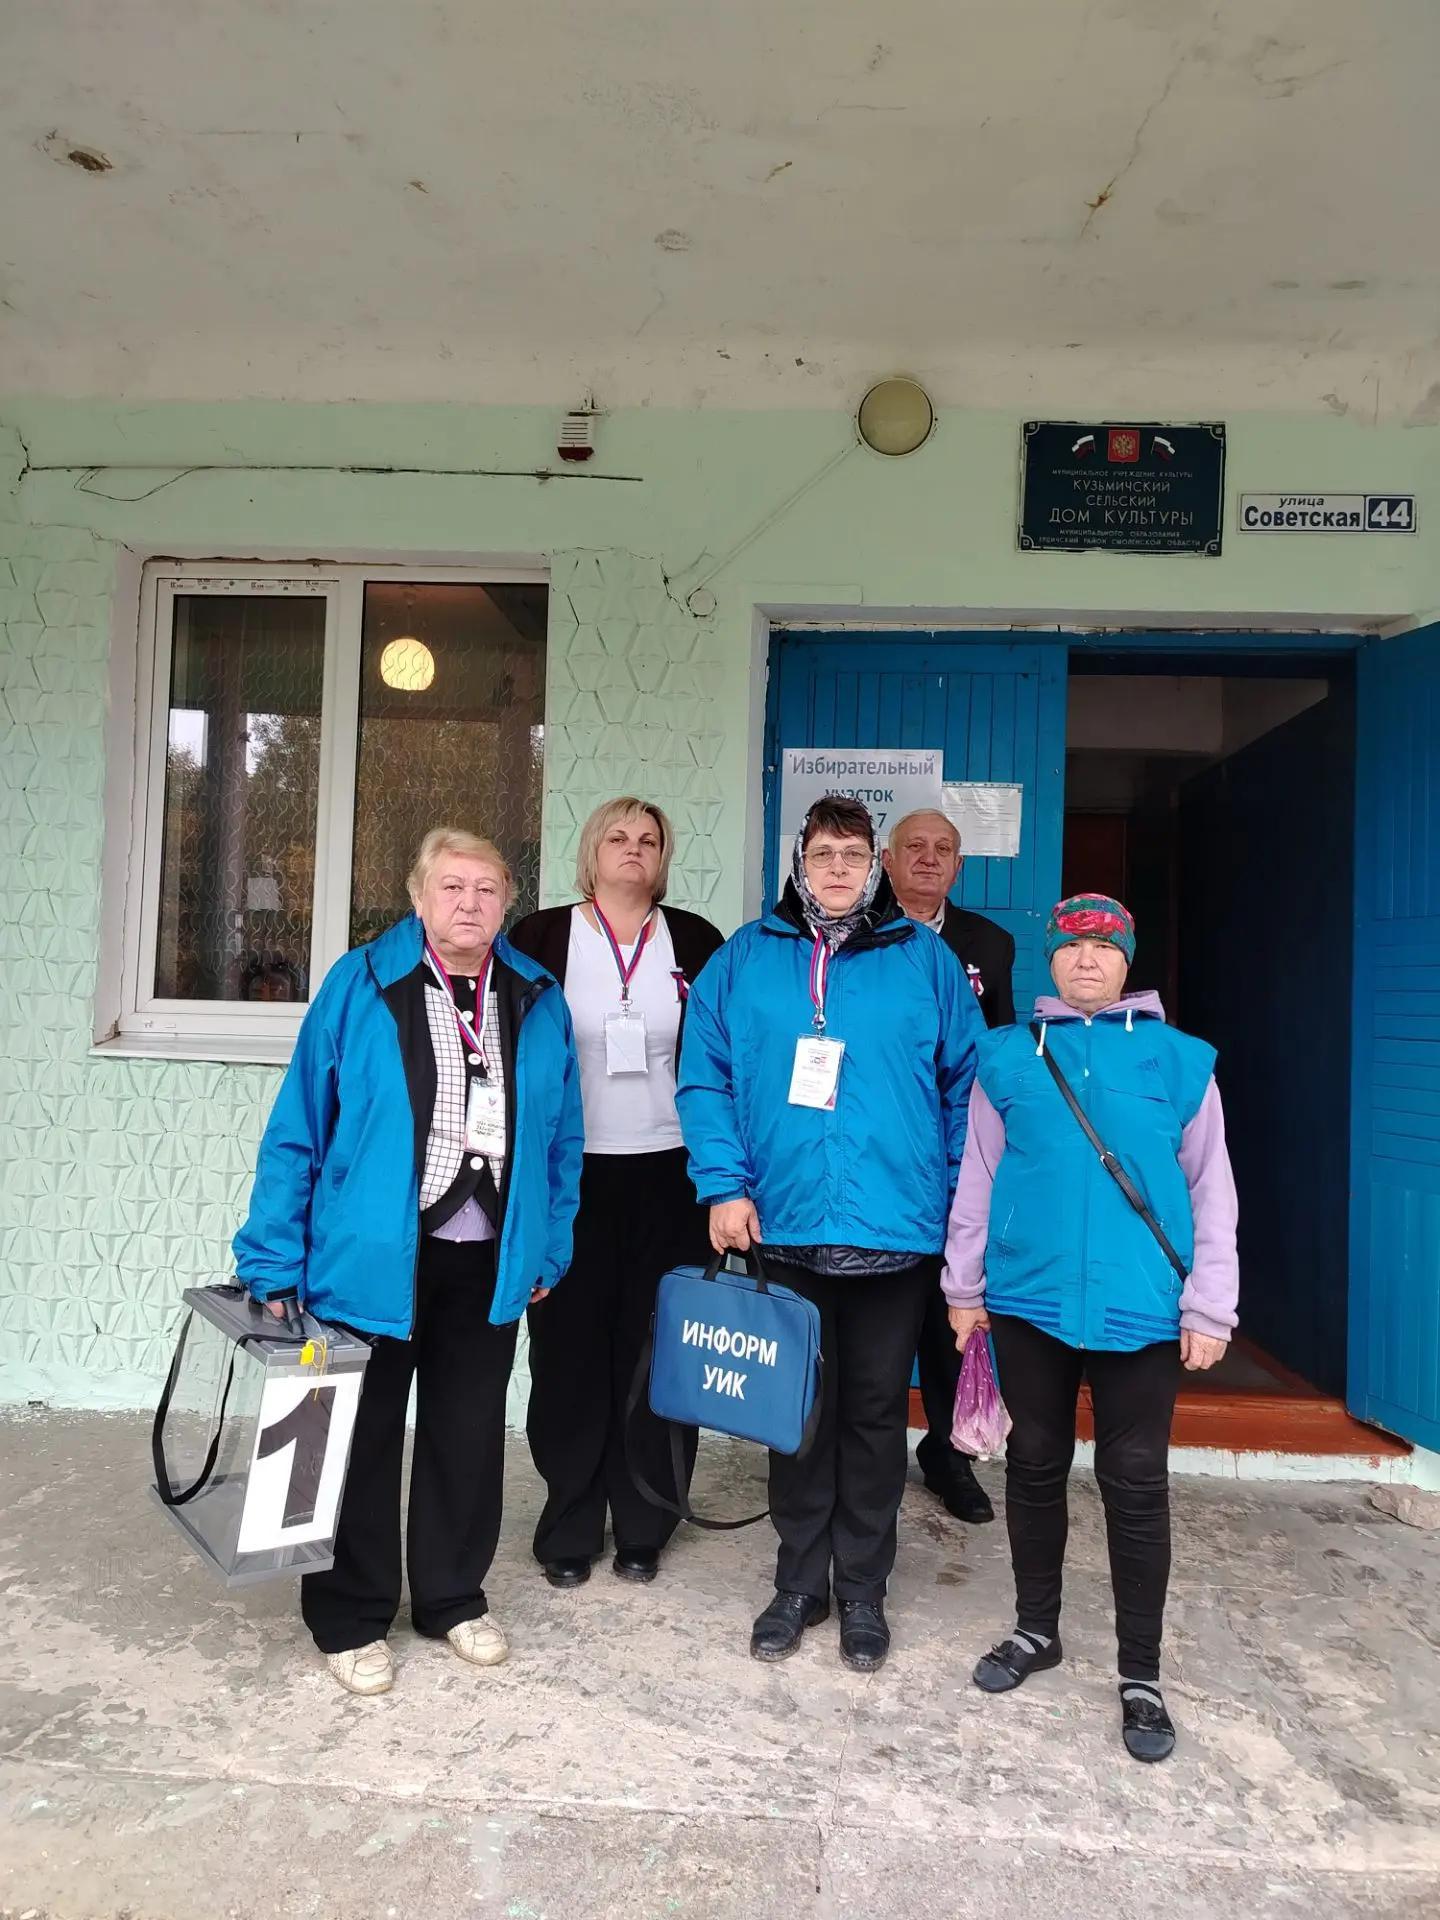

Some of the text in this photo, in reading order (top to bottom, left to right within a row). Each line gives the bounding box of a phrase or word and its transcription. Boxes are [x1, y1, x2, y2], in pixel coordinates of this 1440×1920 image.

[1073, 479, 1171, 493] КУЗЬМИЧСКИЙ
[1086, 494, 1156, 507] СЕЛЬСКИЙ
[1279, 497, 1325, 508] улица
[1049, 508, 1193, 525] ДОМ КУЛЬТУРЫ
[1244, 500, 1410, 527] Советская 44
[792, 756, 934, 778] Избирательный
[682, 1319, 778, 1367] ИНФОРМ
[702, 1364, 748, 1400] УИК
[256, 1385, 337, 1529] 1
